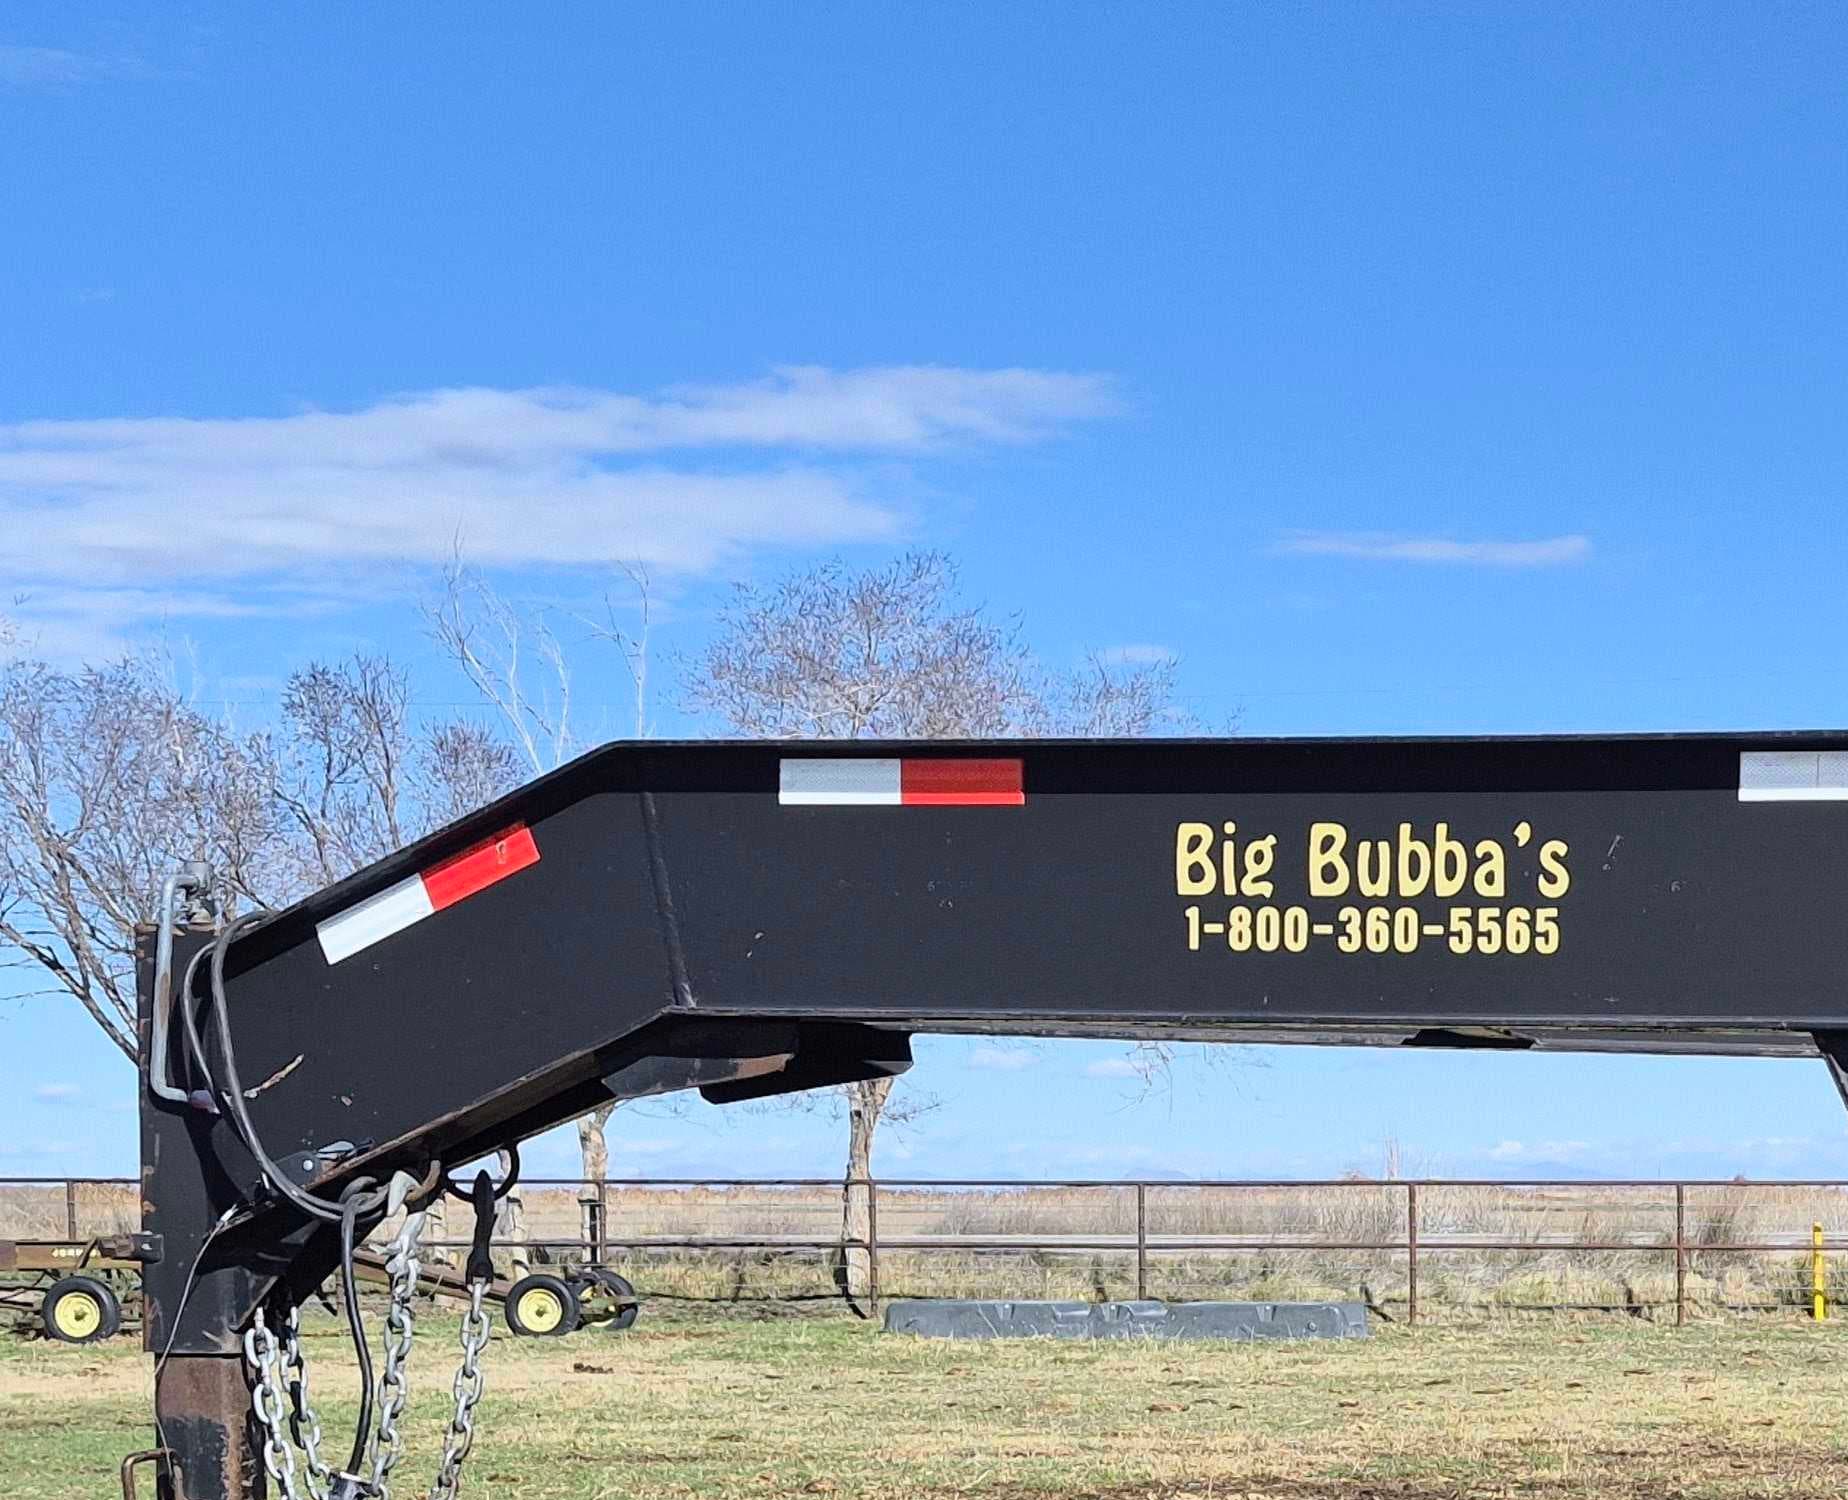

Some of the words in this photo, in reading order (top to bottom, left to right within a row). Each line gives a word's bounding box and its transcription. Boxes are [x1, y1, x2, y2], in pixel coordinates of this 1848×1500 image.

[1175, 821, 1278, 898] Big
[1308, 820, 1571, 898] Bubba's
[1184, 906, 1561, 954] 1-800-360-5565
